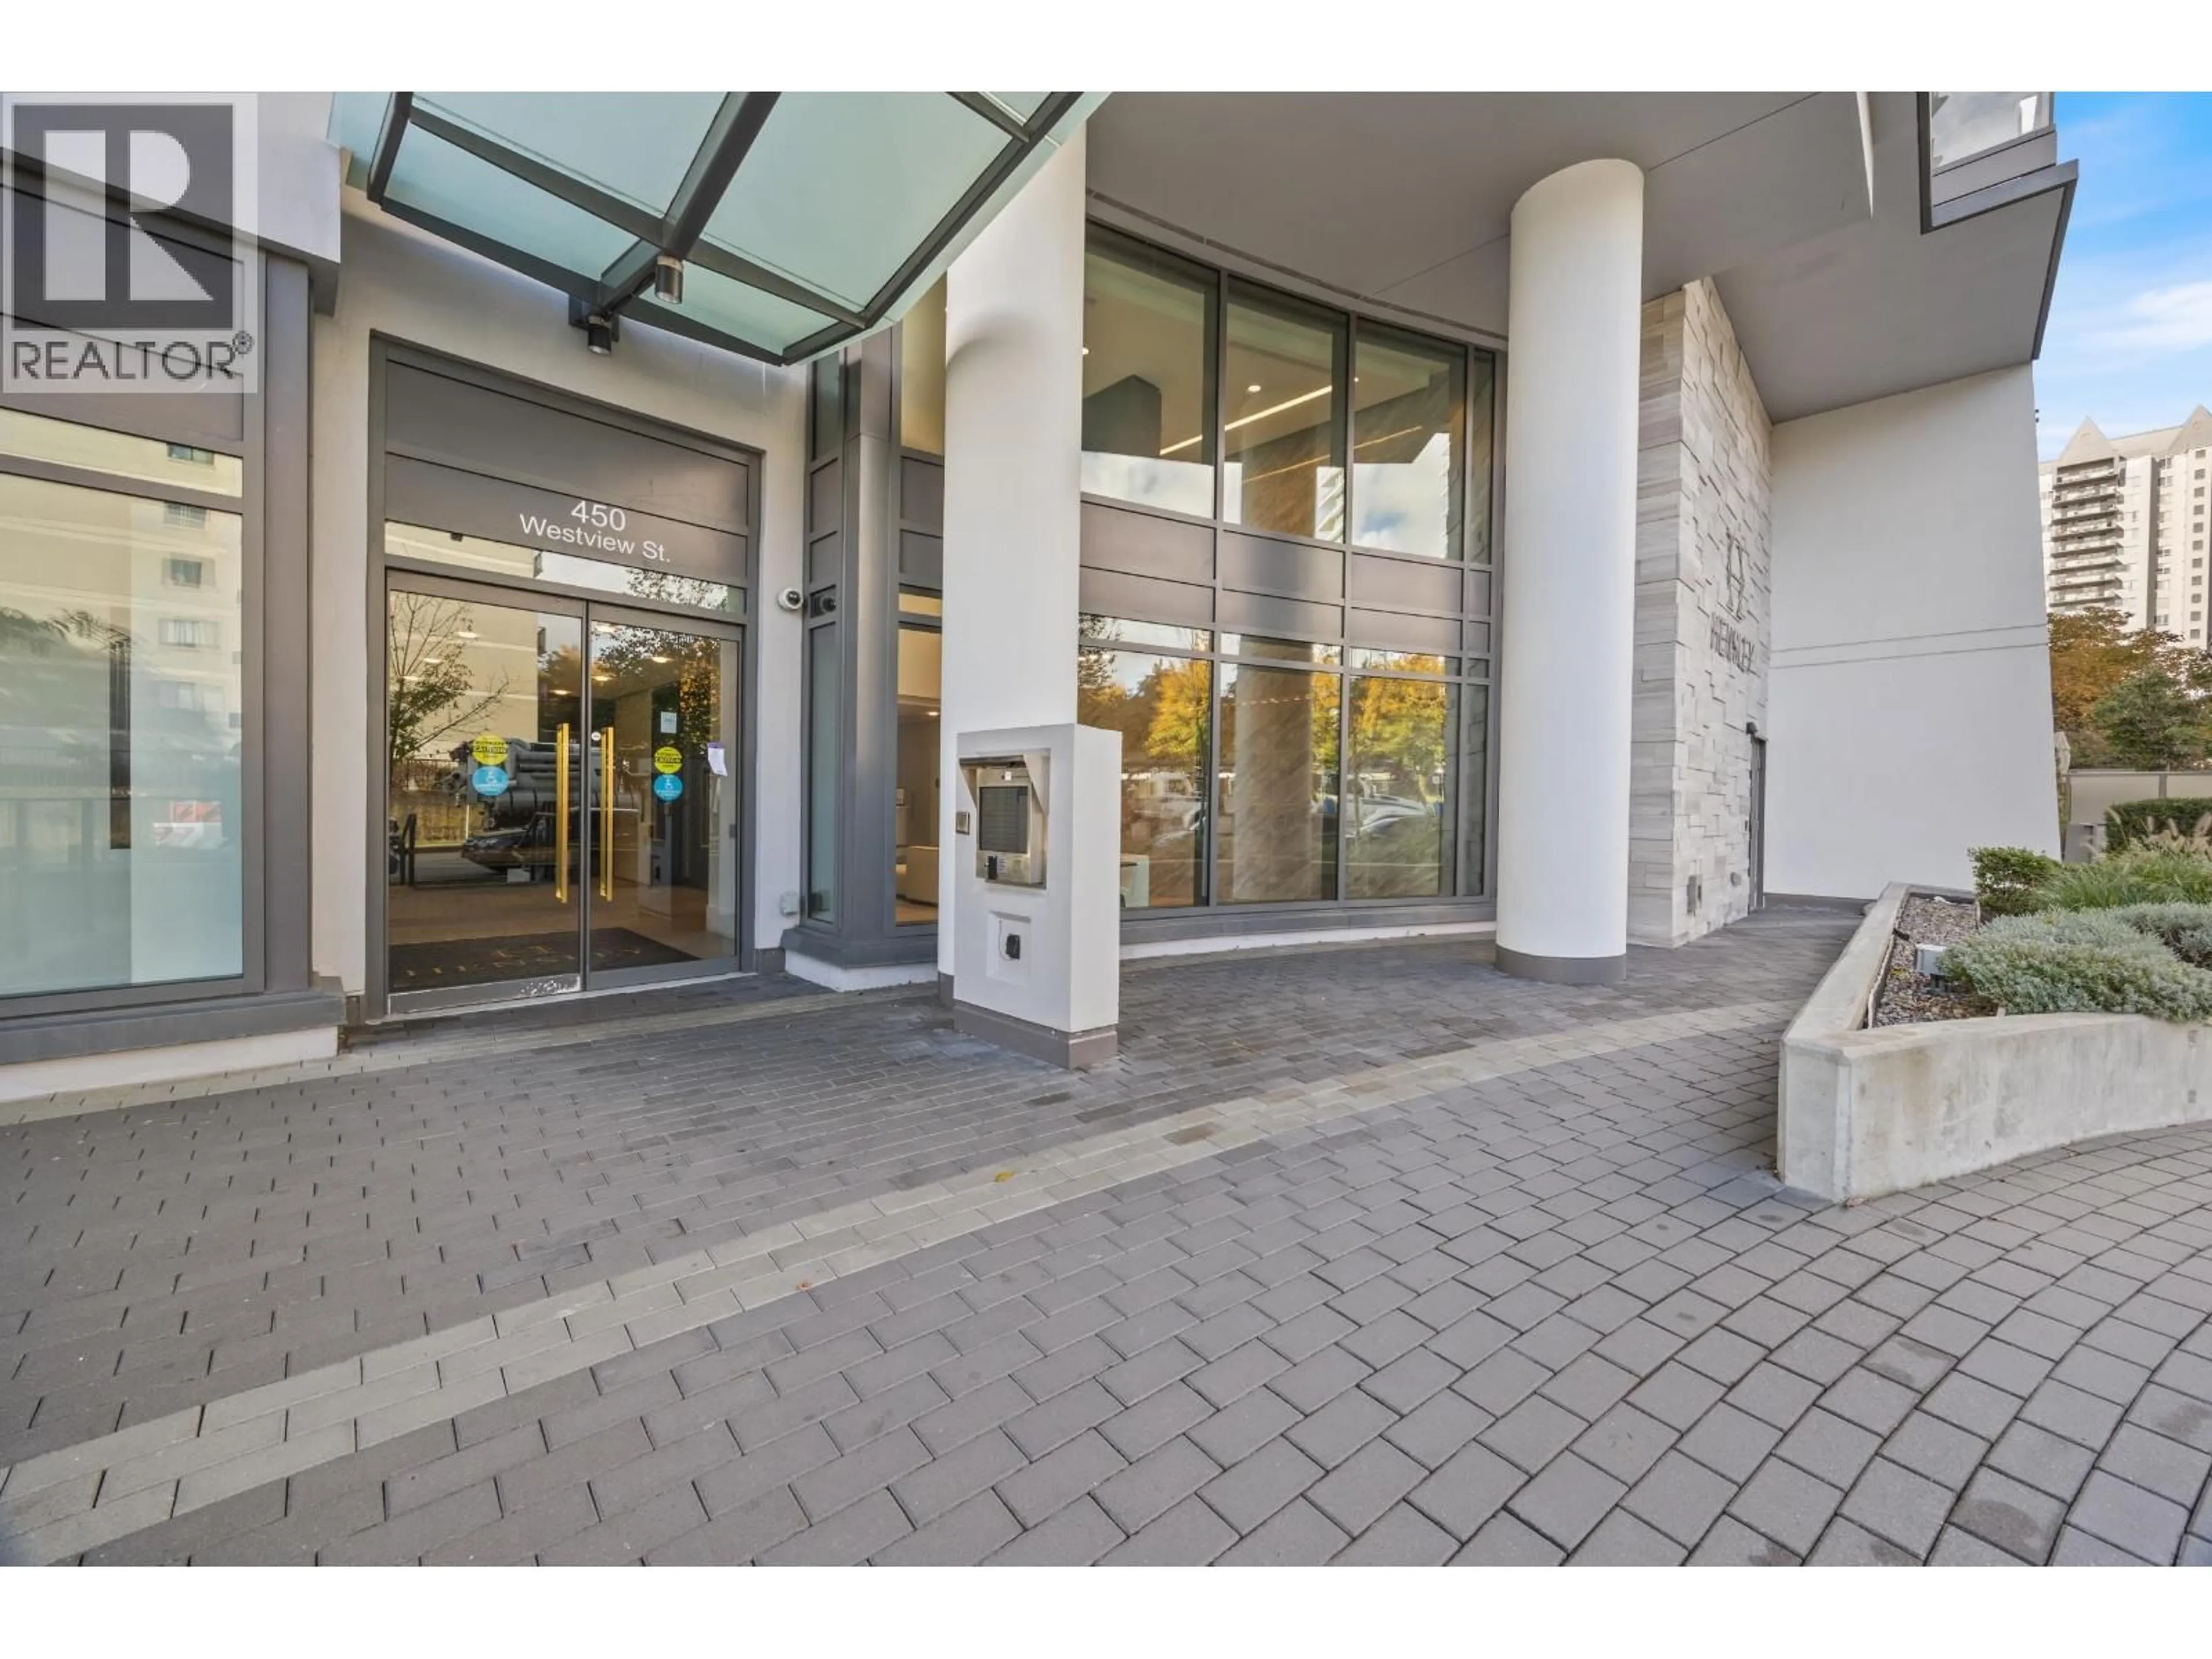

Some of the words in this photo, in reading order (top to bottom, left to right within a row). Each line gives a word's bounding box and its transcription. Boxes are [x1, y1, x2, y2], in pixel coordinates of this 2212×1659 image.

[571, 500, 626, 531] 450
[520, 513, 635, 555] Westview
[642, 540, 671, 562] St.
